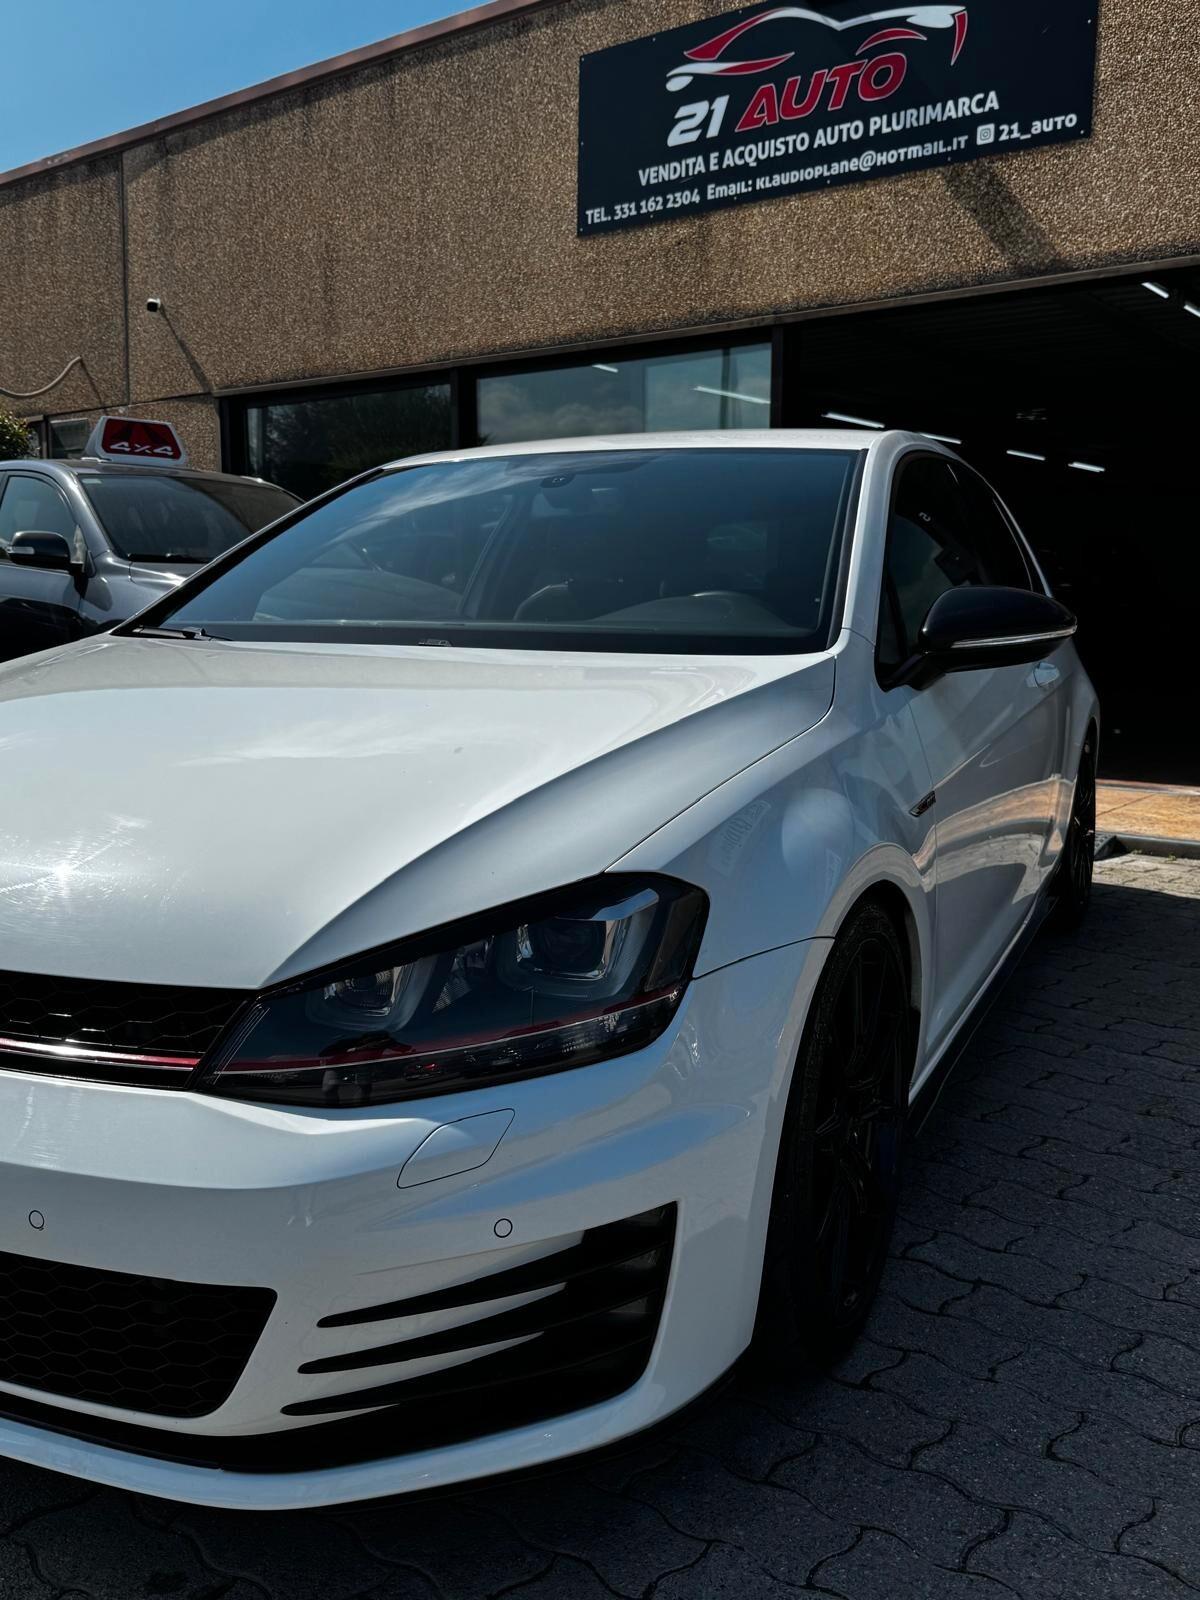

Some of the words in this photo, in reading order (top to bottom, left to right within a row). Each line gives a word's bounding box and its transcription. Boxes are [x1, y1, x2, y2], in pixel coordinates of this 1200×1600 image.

[638, 156, 706, 187] VENDITA
[709, 152, 719, 172] E
[722, 132, 810, 167] ACQUISTO
[813, 120, 864, 149] AUTO
[869, 90, 1000, 137] PLURIMARCA
[666, 94, 730, 147] 21
[735, 52, 907, 132] AUTO
[585, 207, 612, 225] TEL.
[613, 202, 637, 220] 331
[639, 195, 664, 214] 162
[666, 188, 701, 208] 2304
